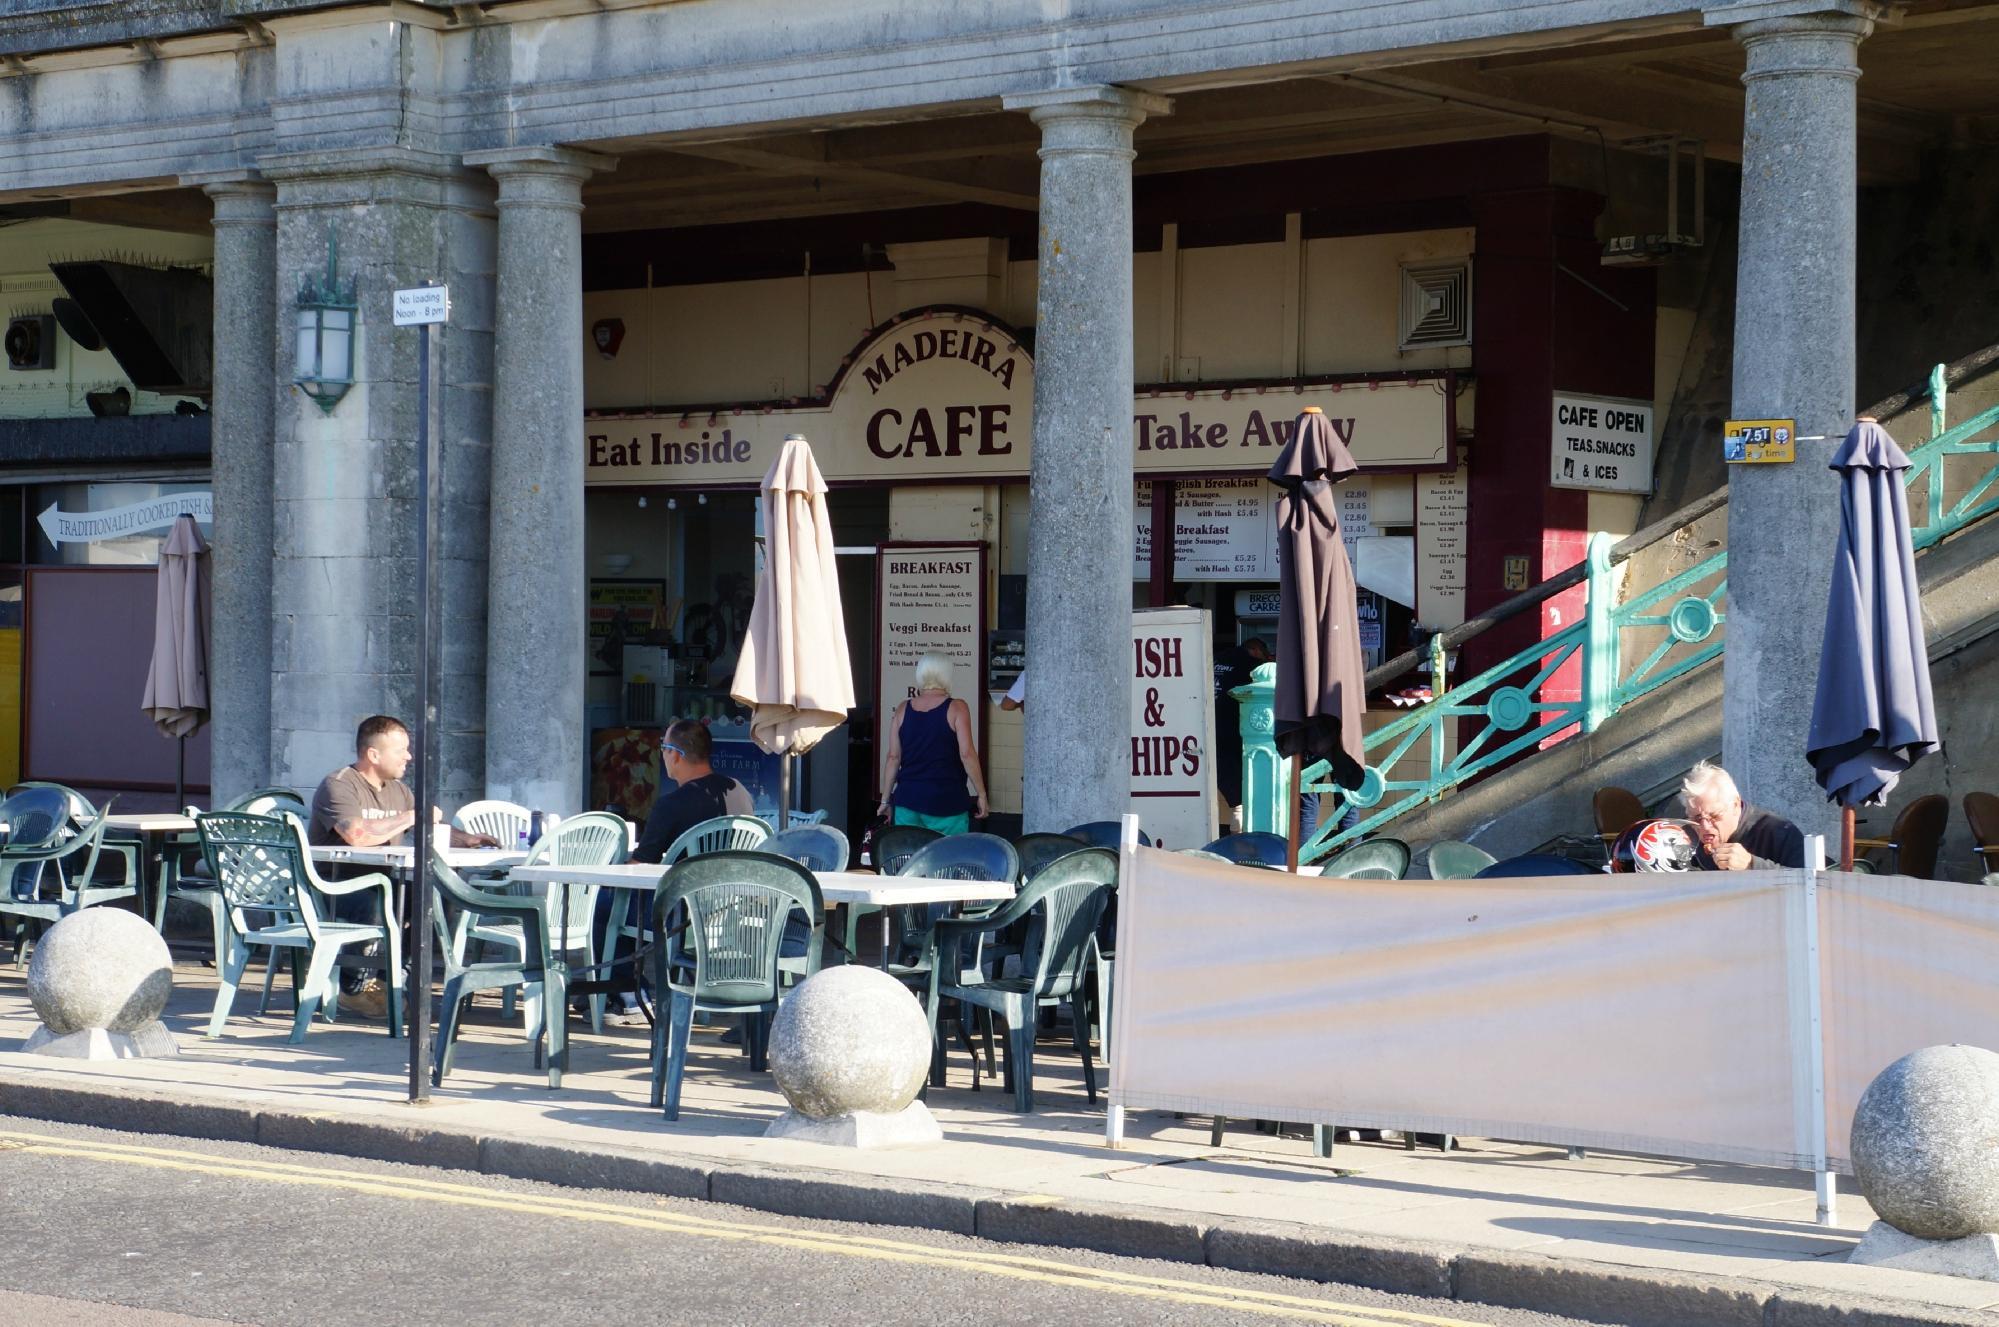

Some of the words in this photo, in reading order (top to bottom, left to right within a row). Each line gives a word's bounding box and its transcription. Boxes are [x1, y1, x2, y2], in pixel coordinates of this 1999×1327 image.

[399, 295, 410, 304] No
[412, 293, 441, 304] loading
[395, 309, 416, 319] Noon
[424, 306, 430, 317] 8
[431, 307, 444, 316] pm
[862, 329, 1016, 395] MADEIRA
[1558, 404, 1598, 429] CAFE
[1605, 409, 1645, 434] OPEN
[866, 404, 1012, 459] CAFE
[1133, 411, 1229, 451] Take
[1240, 409, 1356, 449] Awy
[1742, 428, 1770, 442] 7.5T
[588, 434, 641, 467] Eat
[650, 429, 752, 465] Inside
[1582, 464, 1590, 478] &
[1594, 465, 1618, 480] ICES
[1204, 478, 1259, 489] Breakfast
[58, 511, 136, 537] TRADITIONALLY
[137, 500, 179, 526] COOKED
[179, 498, 201, 515] FISH
[203, 499, 213, 515] &
[1197, 509, 1213, 517] with
[1215, 509, 1232, 517] Hash
[1237, 509, 1259, 517] £5.45
[1176, 525, 1230, 535] Breakfast
[1195, 538, 1230, 546] Sausages,
[1235, 554, 1257, 562] £5.25
[890, 562, 972, 574] BREAKFAST
[1212, 565, 1230, 573] Hash
[1235, 565, 1256, 573] £5.75
[1250, 593, 1281, 602] BRECO
[889, 623, 918, 635] Veggi
[921, 623, 972, 632] Breakfast
[1131, 637, 1184, 678] ISH
[1144, 687, 1166, 727] &
[1131, 735, 1200, 776] HIPS
